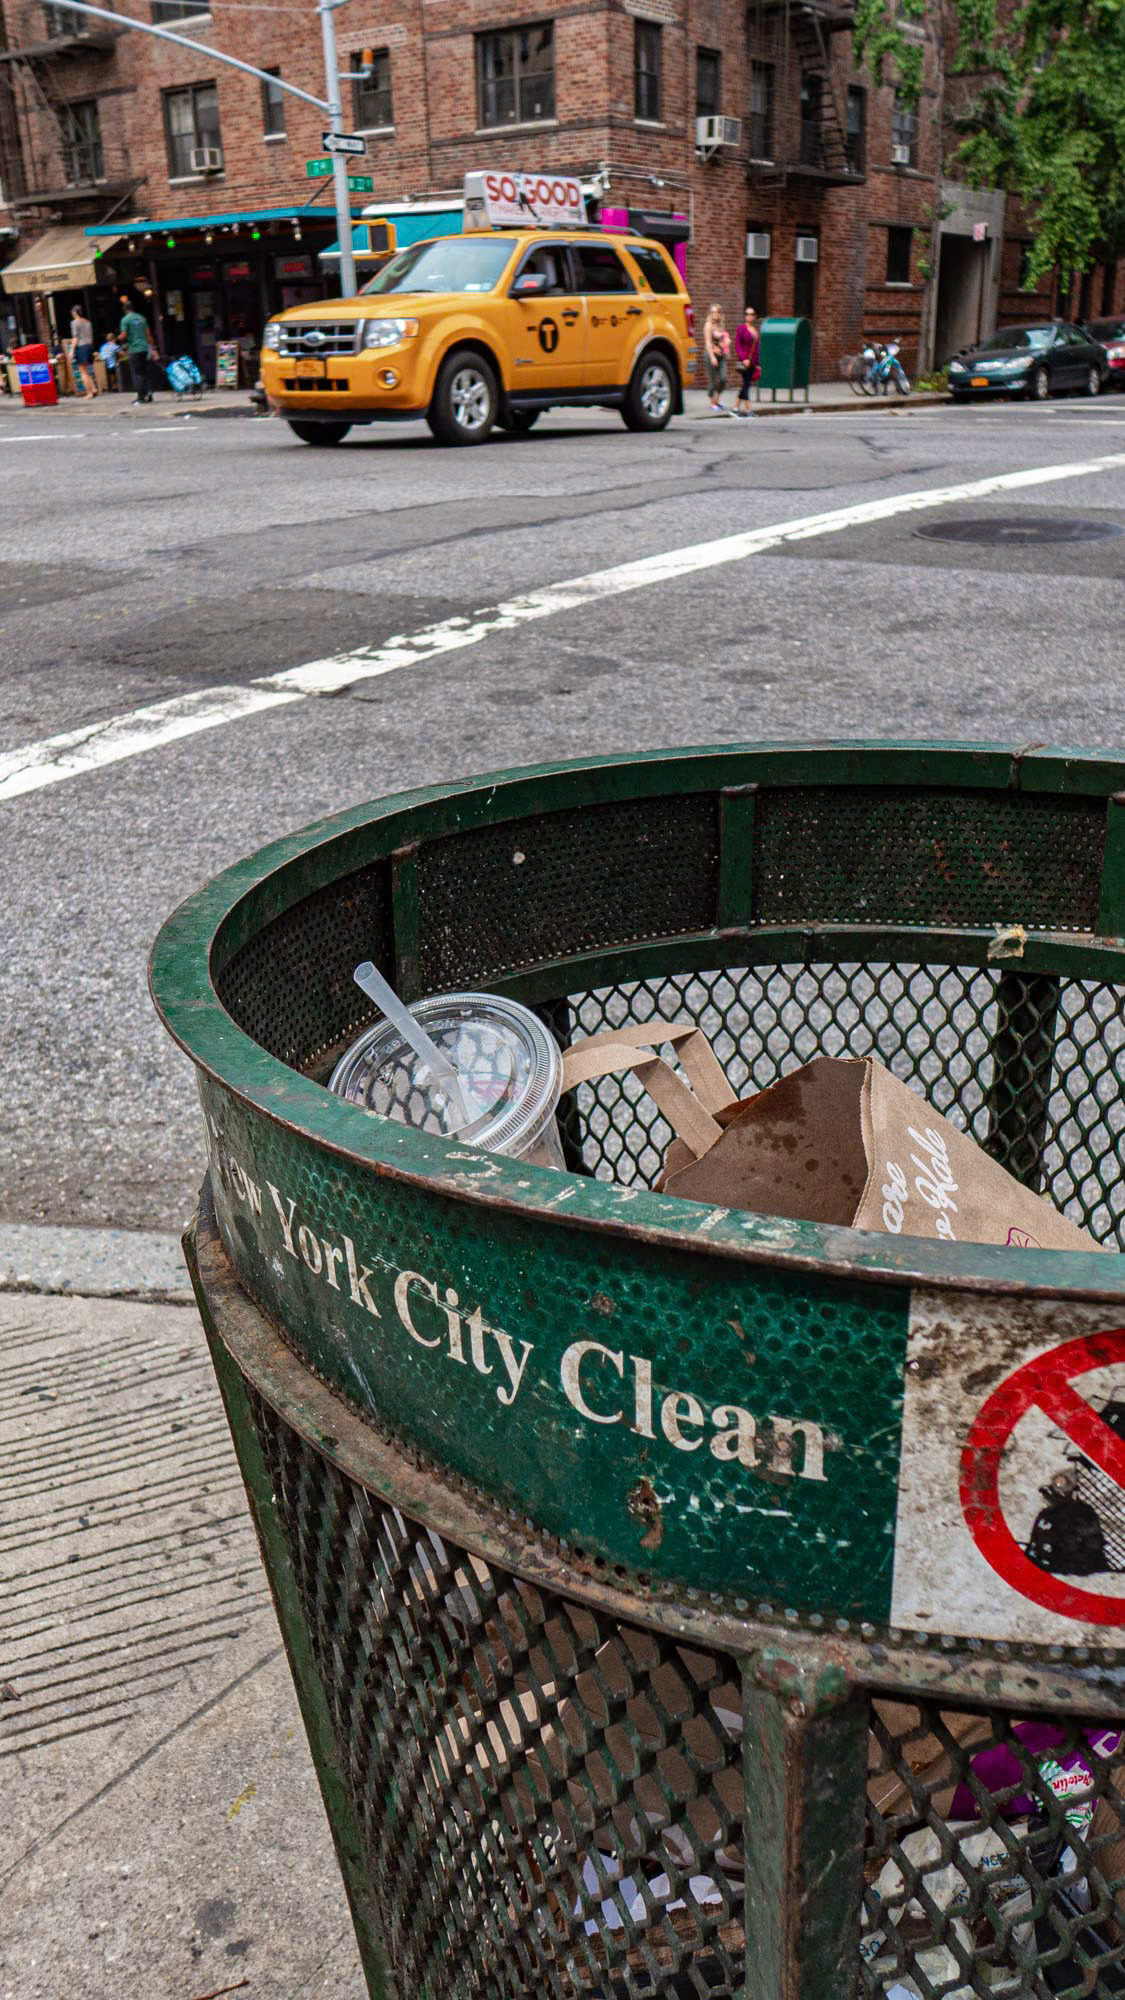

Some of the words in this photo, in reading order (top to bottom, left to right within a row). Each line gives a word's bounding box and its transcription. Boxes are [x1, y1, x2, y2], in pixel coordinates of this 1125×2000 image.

[486, 175, 516, 202] SO
[265, 1179, 382, 1319] York
[393, 1270, 534, 1406] City
[559, 1339, 829, 1483] Clean
